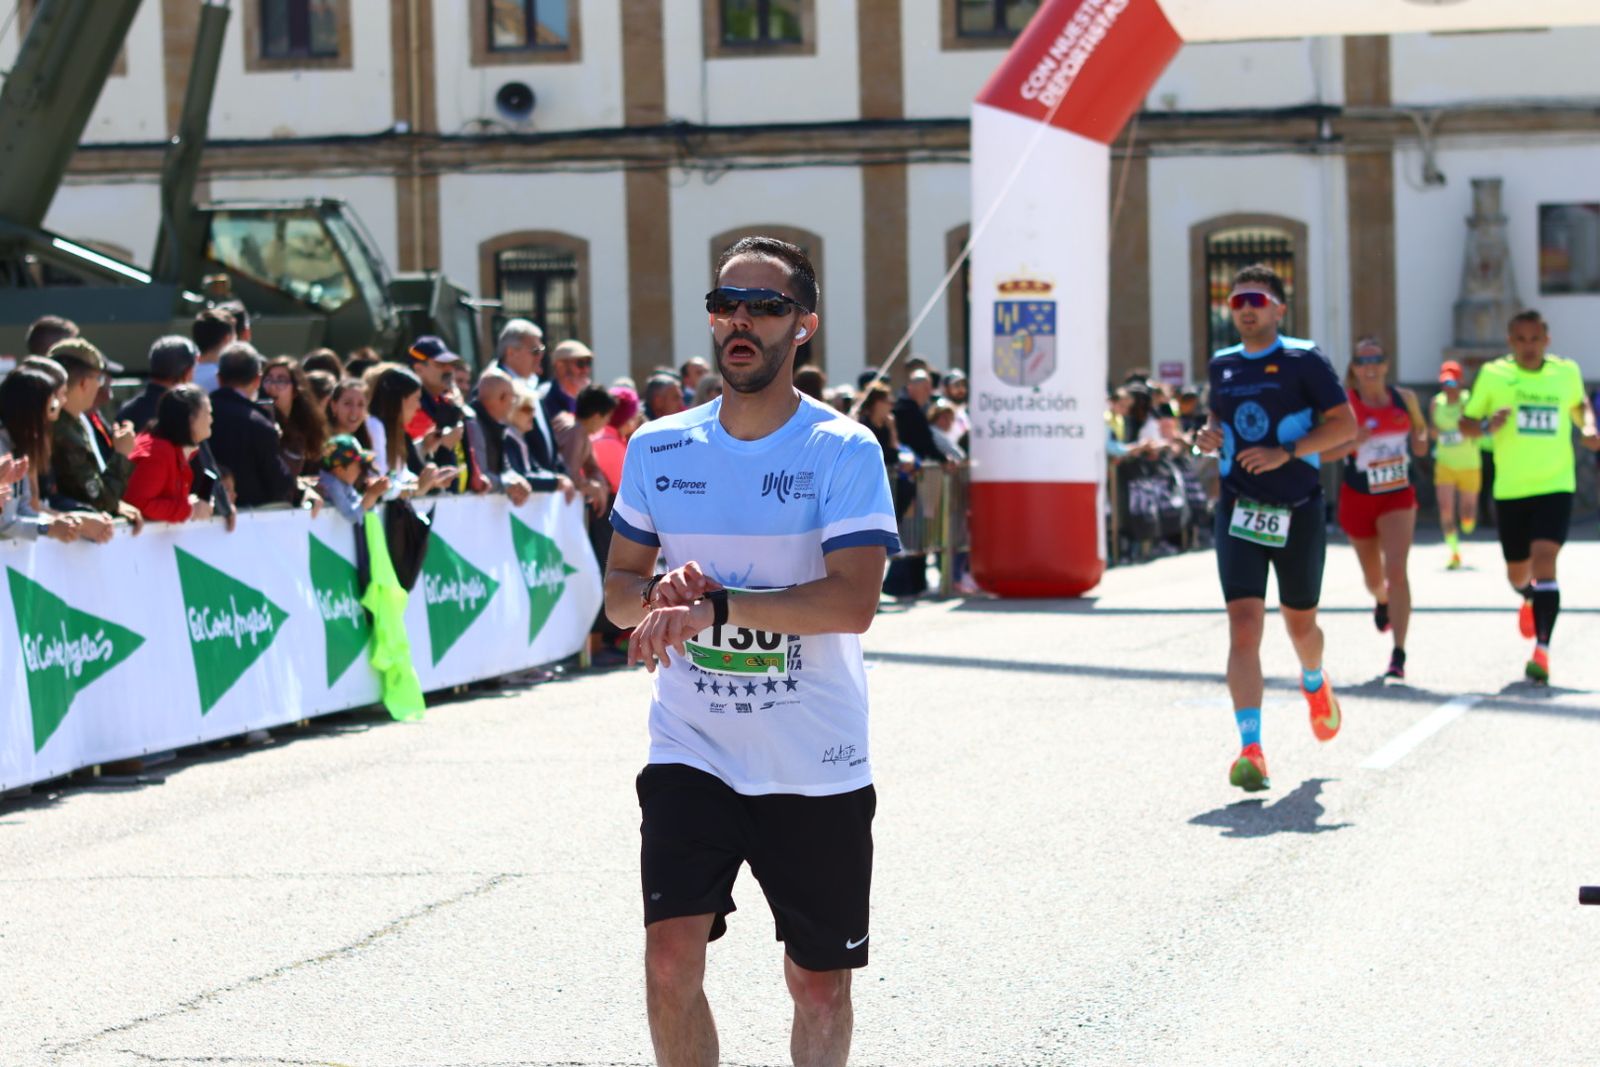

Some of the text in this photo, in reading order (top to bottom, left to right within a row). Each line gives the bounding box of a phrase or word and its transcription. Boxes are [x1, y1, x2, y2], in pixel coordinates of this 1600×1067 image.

[1020, 55, 1058, 100] CON
[979, 392, 1078, 416] Diputación
[987, 418, 1085, 439] Salamanca
[650, 440, 682, 454] luanvi
[671, 479, 708, 490] Elproex
[1243, 511, 1280, 533] 756
[188, 594, 273, 650] El Corte Inglés
[23, 620, 114, 680] El Corte Inglés
